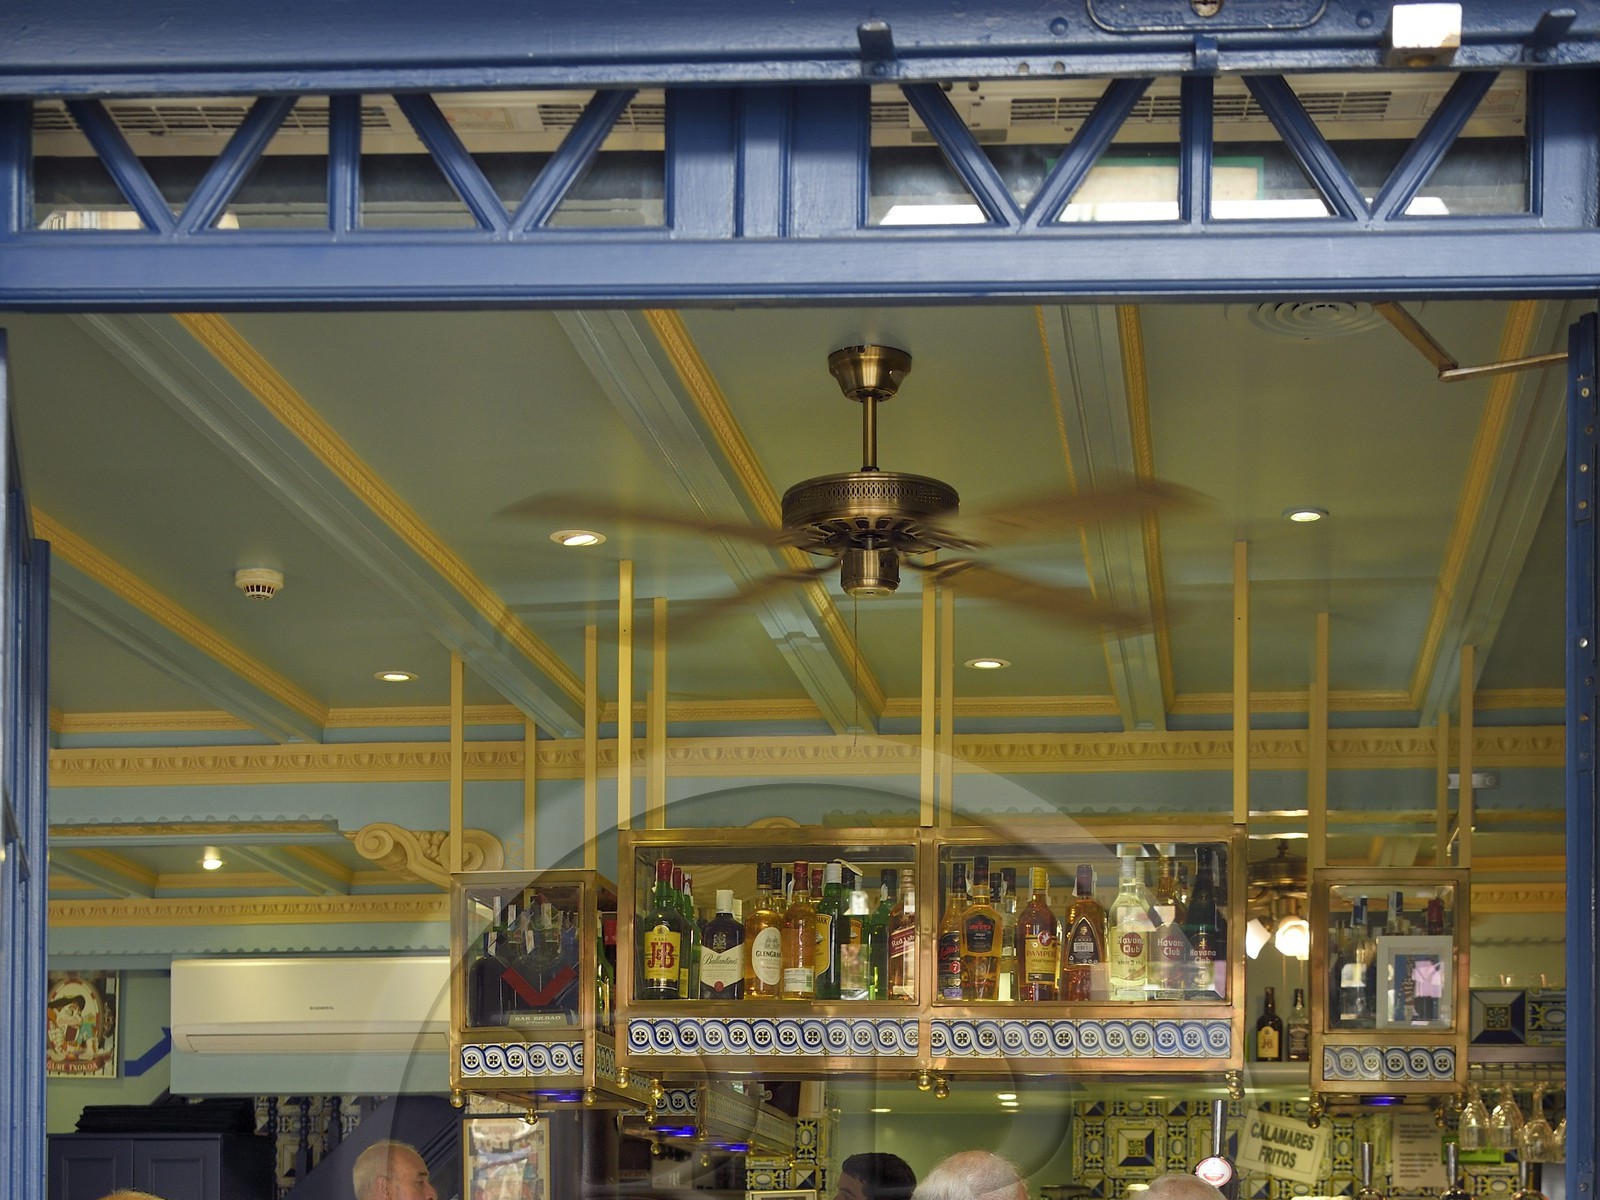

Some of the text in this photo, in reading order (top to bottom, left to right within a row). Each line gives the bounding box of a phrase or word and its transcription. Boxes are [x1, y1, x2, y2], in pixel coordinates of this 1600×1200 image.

[903, 934, 915, 943] Lab
[1251, 1122, 1315, 1151] CALAMARES
[1258, 1145, 1297, 1169] FRITOS
